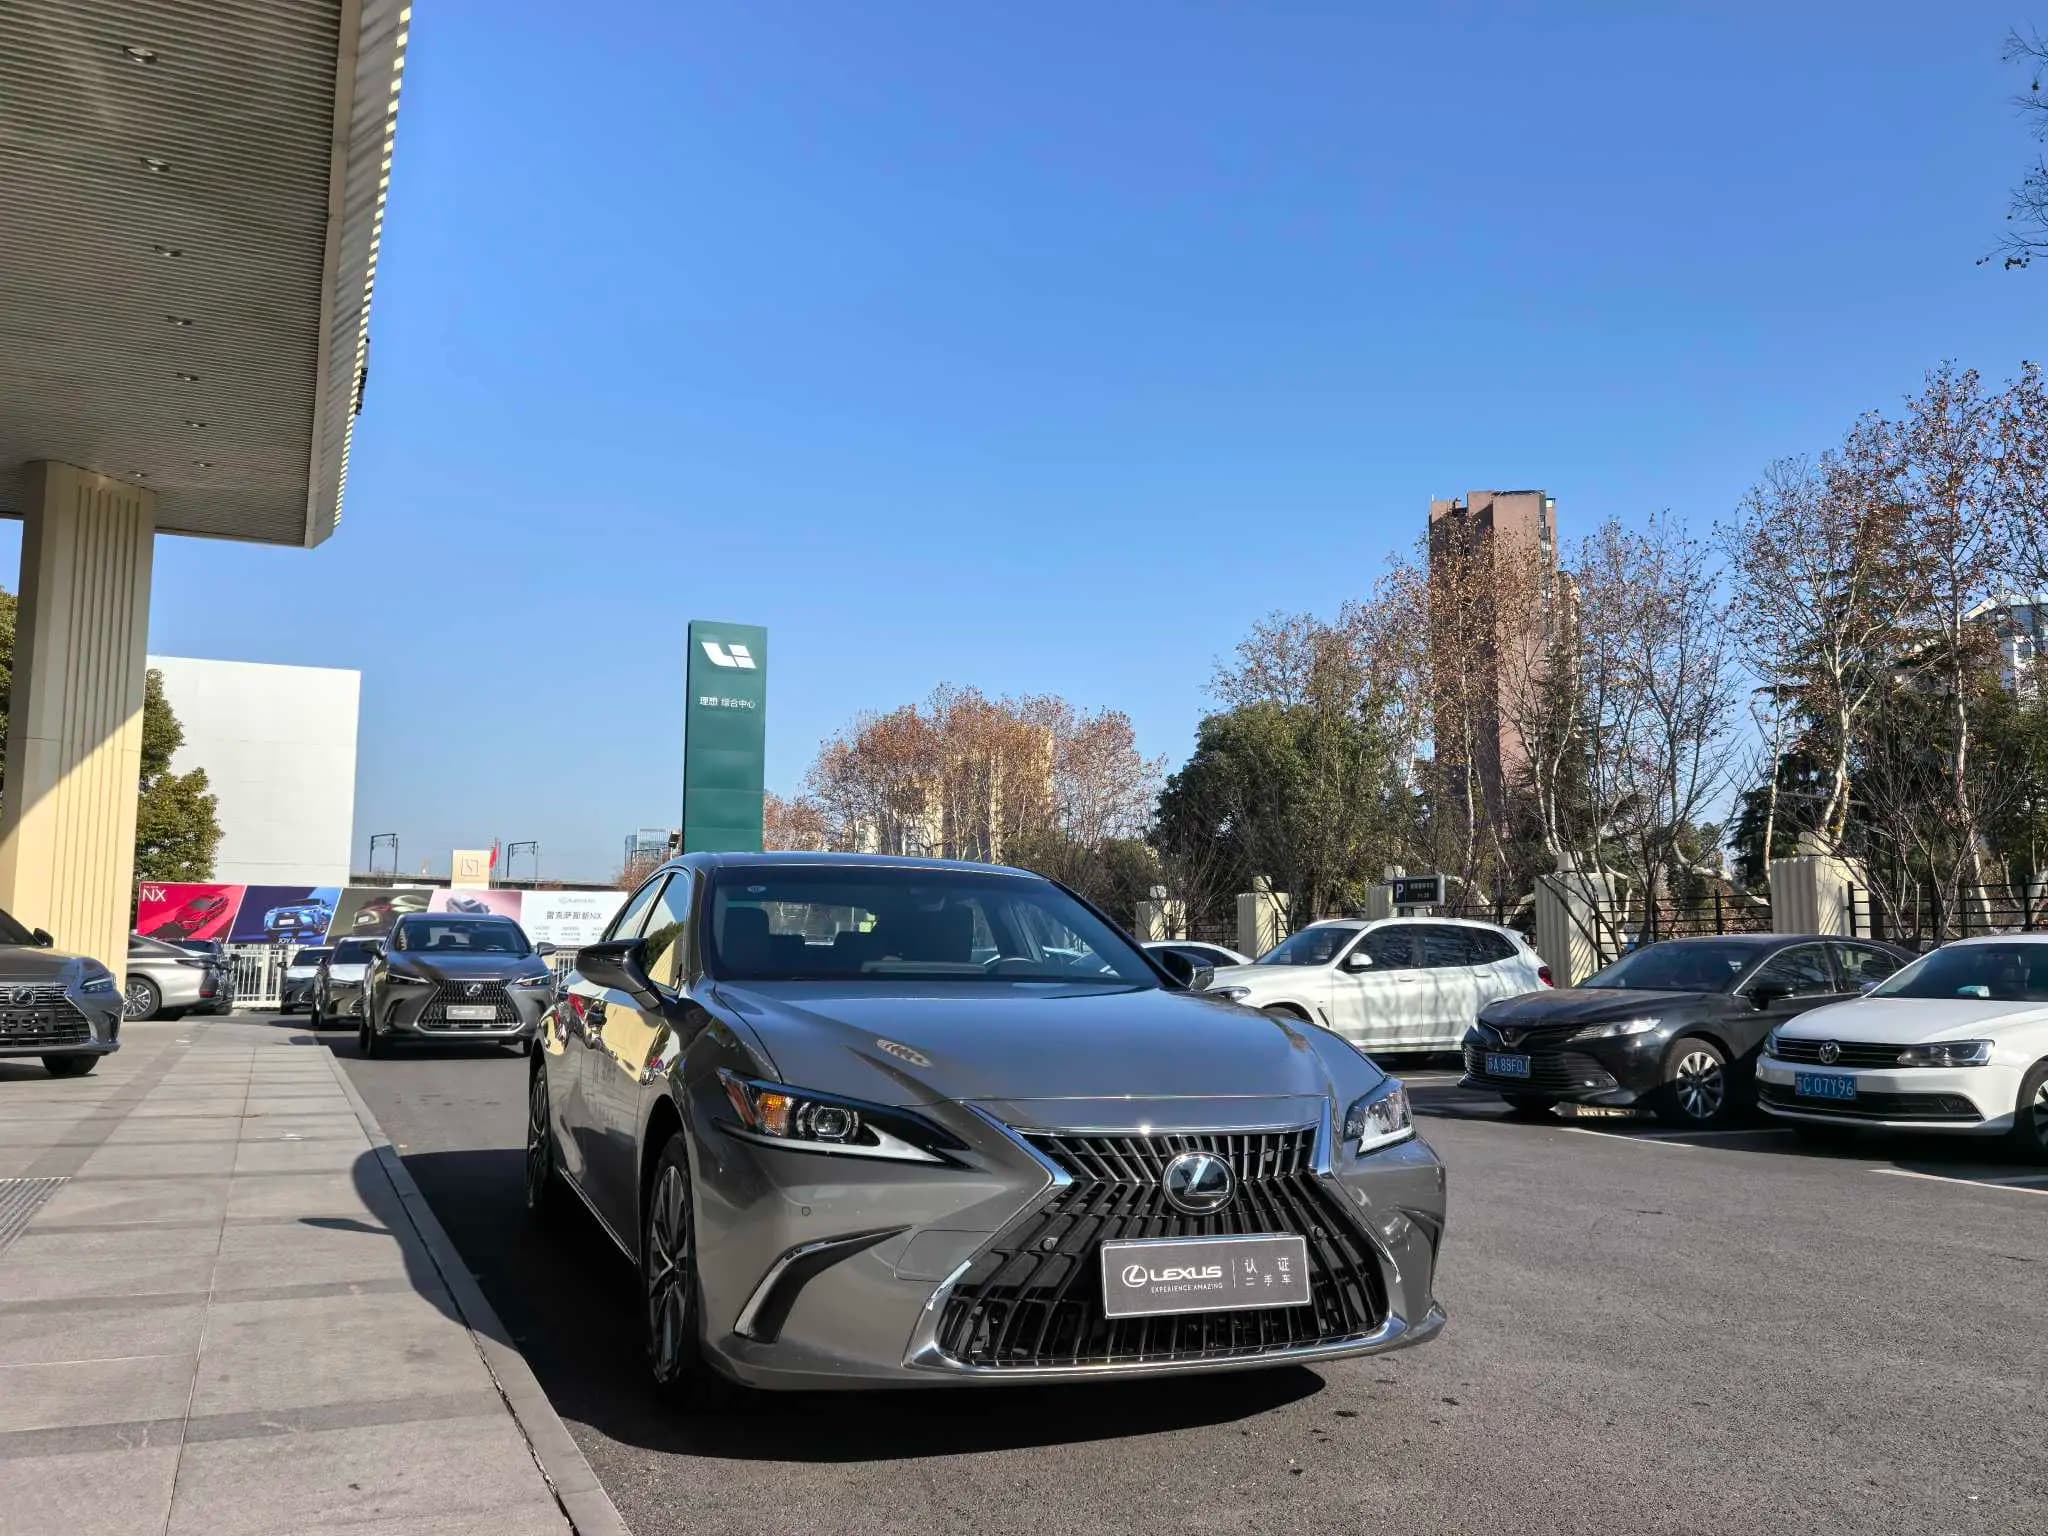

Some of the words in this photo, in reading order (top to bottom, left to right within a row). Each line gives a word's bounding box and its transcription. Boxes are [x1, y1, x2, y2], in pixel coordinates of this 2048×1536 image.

[142, 888, 167, 902] NX
[1396, 883, 1404, 899] P
[1244, 1256, 1290, 1274] 认证
[1150, 1265, 1223, 1281] LEXUS
[1245, 1273, 1292, 1287] 二手车
[1151, 1284, 1192, 1295] EXPERIENCE
[1193, 1281, 1224, 1291] AMAZING
